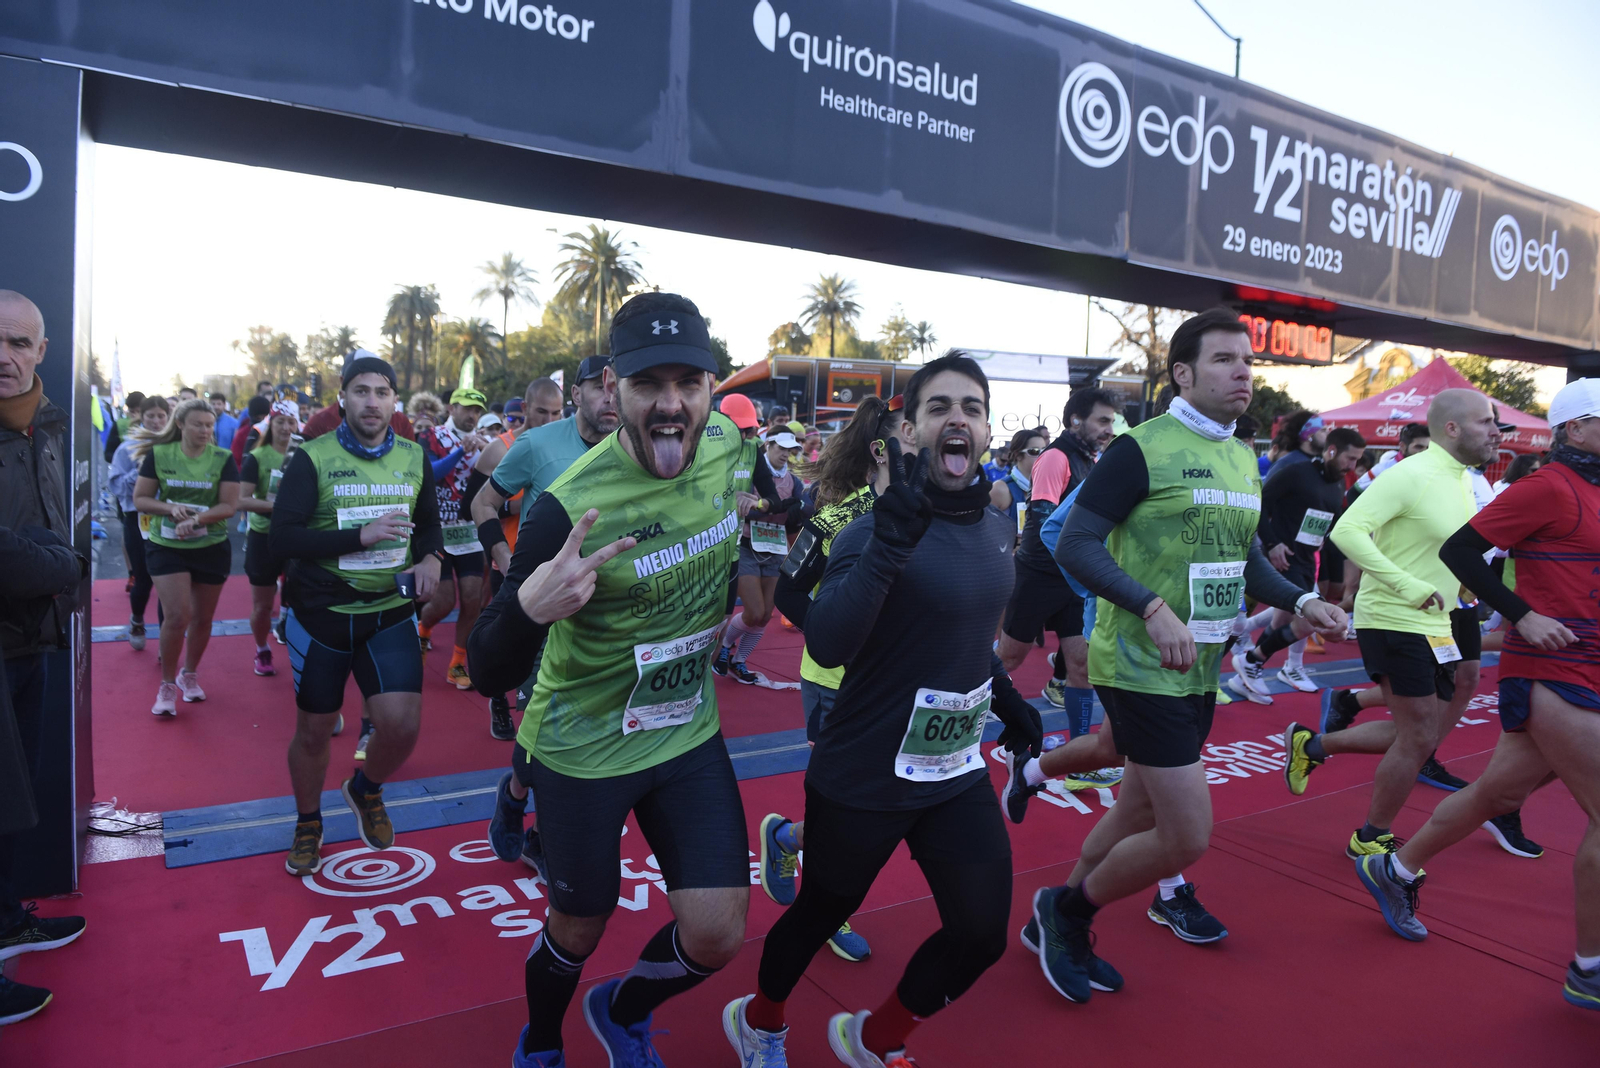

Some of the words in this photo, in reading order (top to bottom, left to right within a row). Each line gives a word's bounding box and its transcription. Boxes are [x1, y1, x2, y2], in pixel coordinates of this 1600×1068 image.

[484, 0, 595, 43] Motor
[788, 31, 978, 106] quirónsalud
[820, 86, 913, 128] Healthcare
[917, 110, 976, 143] Partner
[1137, 95, 1235, 190] edp
[1295, 140, 1433, 216] maratón
[1330, 196, 1435, 258] sevilla
[1223, 225, 1246, 253] 29
[1249, 236, 1300, 265] enero
[1305, 243, 1343, 274] 2023
[1523, 230, 1569, 291] edp
[166, 479, 185, 488] MEDIO
[185, 481, 213, 489] MARATÓN
[328, 469, 357, 479] HOKA
[333, 484, 368, 496] MEDIO
[371, 482, 414, 497] MARATÓN
[1182, 468, 1214, 479] HOKA
[1193, 488, 1225, 505] MEDIO
[446, 528, 470, 541] 5032
[633, 543, 686, 580] MEDIO
[686, 509, 739, 557] MARATÓN
[757, 528, 779, 539] 5494
[1203, 582, 1239, 608] 6657
[664, 643, 684, 656] edp
[650, 653, 708, 692] 6033
[943, 697, 961, 709] edp
[1079, 697, 1093, 735] kalenji
[924, 709, 979, 742] 6034
